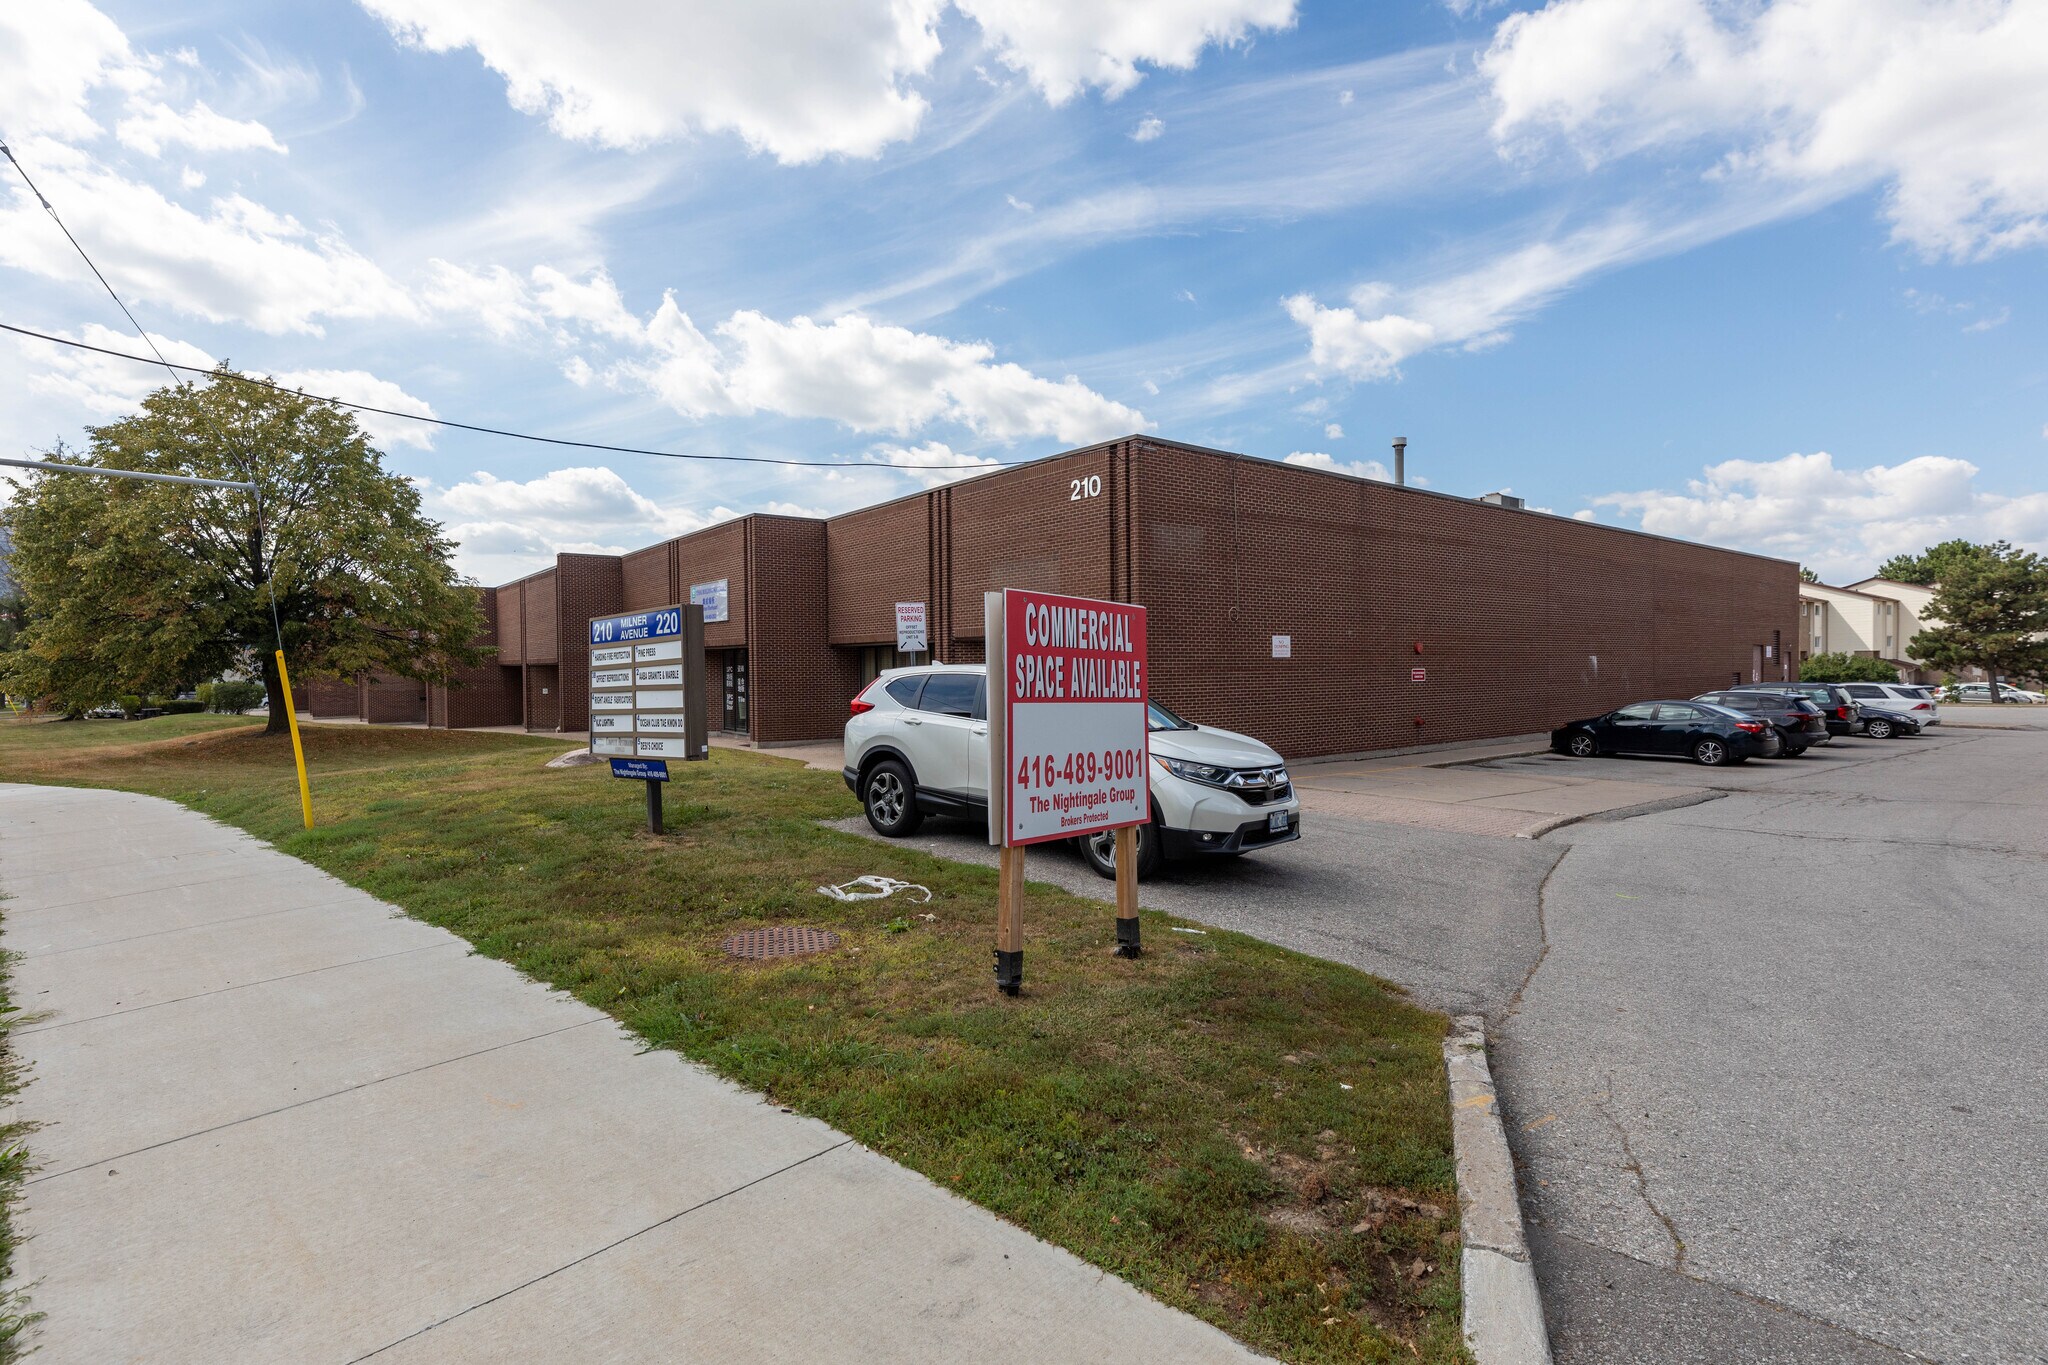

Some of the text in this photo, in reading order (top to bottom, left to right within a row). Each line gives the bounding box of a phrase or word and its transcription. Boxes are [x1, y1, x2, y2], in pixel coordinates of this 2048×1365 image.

[1071, 475, 1101, 501] 210
[897, 606, 924, 614] RESERVED
[900, 615, 923, 623] PARKING
[620, 615, 647, 628] MILNER
[656, 612, 678, 635] 220
[1025, 602, 1133, 653] COMMERCIAL
[594, 622, 613, 642] 210
[620, 627, 649, 640] AVENUE
[1015, 653, 1141, 698] SPACE AVAILABLE
[640, 718, 651, 728] OCEAN
[651, 718, 660, 728] CLUB
[667, 718, 677, 728] KWON
[1017, 748, 1142, 790] 416-489-9001
[1029, 786, 1136, 813] The Nightingale Group
[1060, 810, 1109, 827] Brokers Protected
